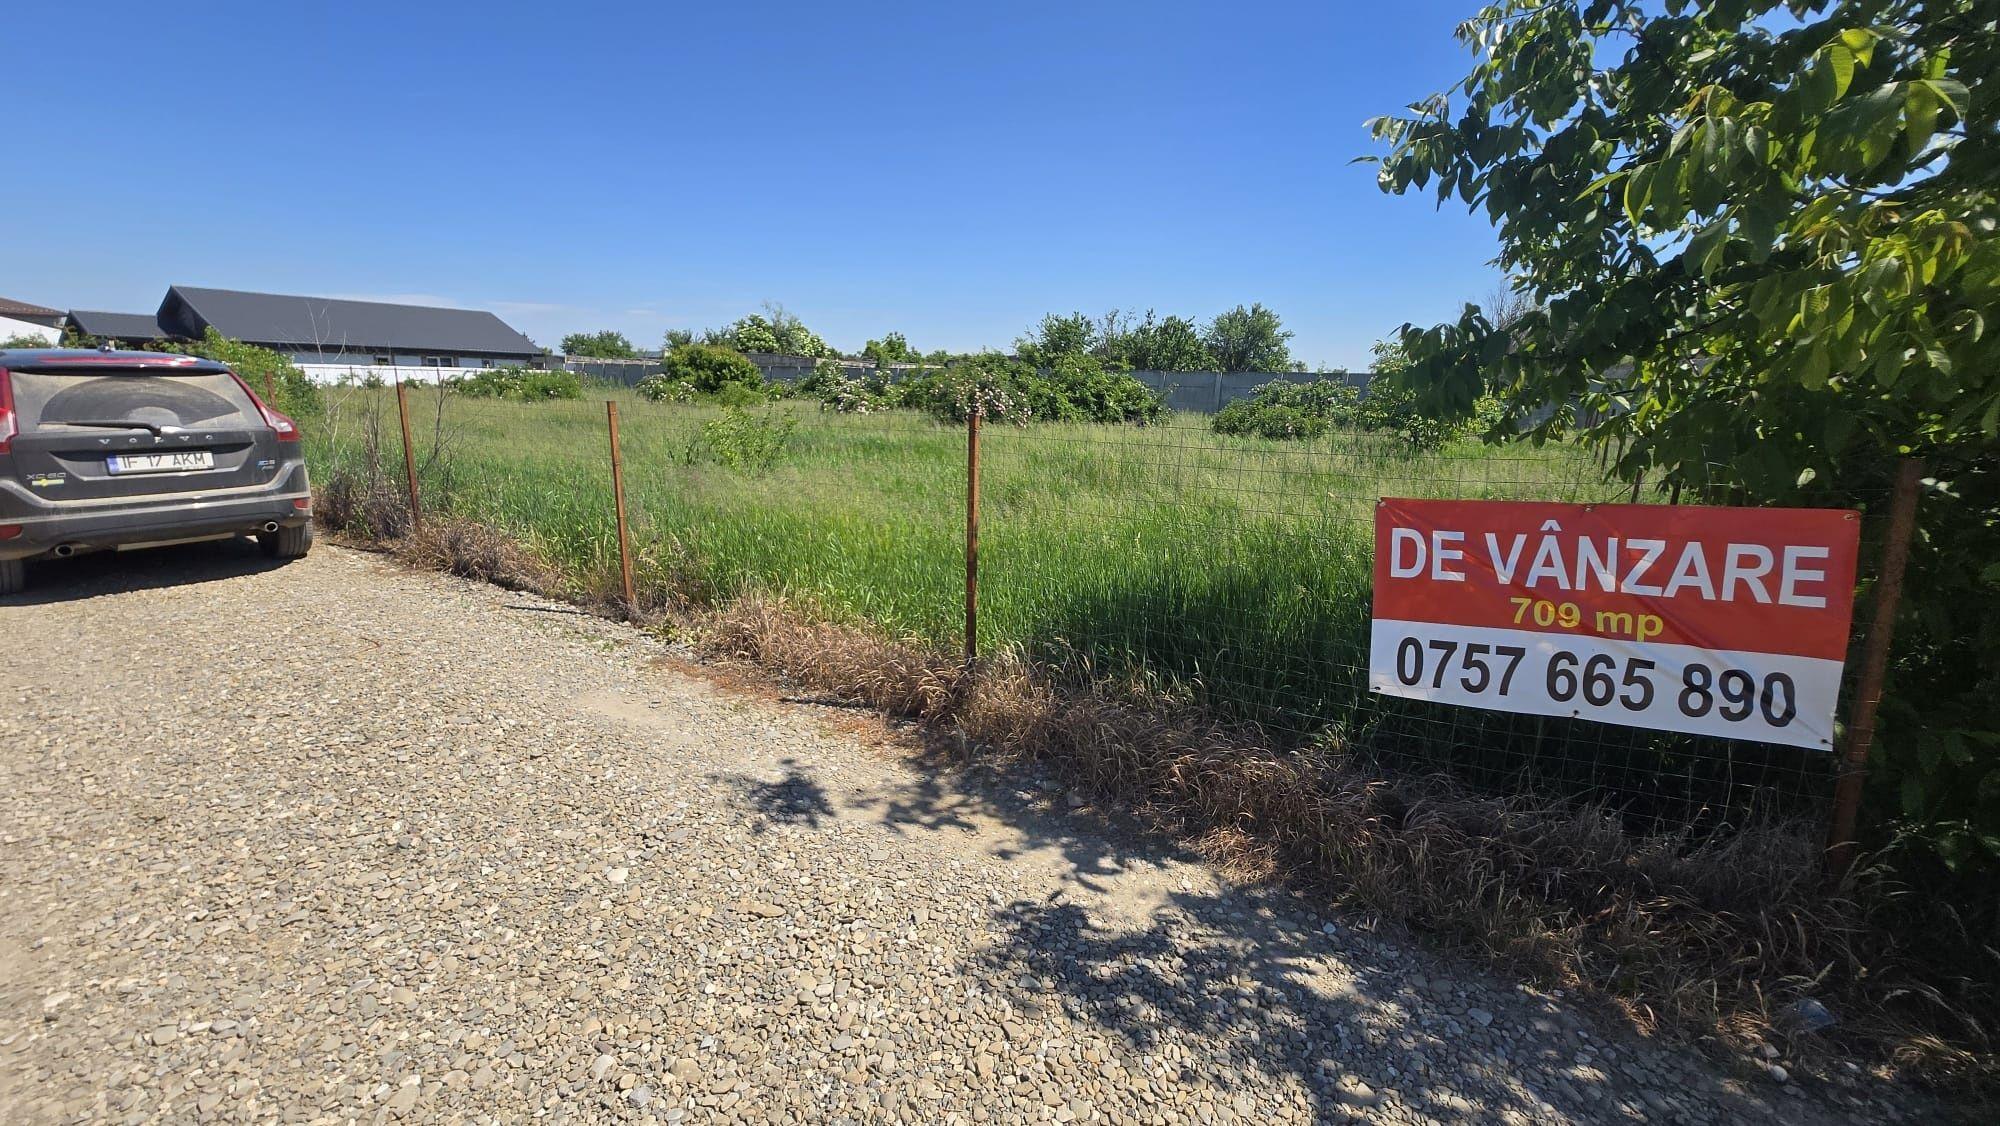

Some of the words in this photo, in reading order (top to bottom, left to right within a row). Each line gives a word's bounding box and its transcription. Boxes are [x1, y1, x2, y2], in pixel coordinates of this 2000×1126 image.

[122, 455, 138, 469] IF
[148, 455, 161, 467] 17
[173, 452, 206, 466] AKM
[1390, 527, 1465, 581] DE
[1485, 519, 1830, 608] VÂNZARE
[1509, 597, 1580, 628] 709
[1596, 610, 1664, 642] mp
[1396, 636, 1526, 697] 0757
[1546, 651, 1656, 712] 665
[1678, 663, 1796, 727] 890
